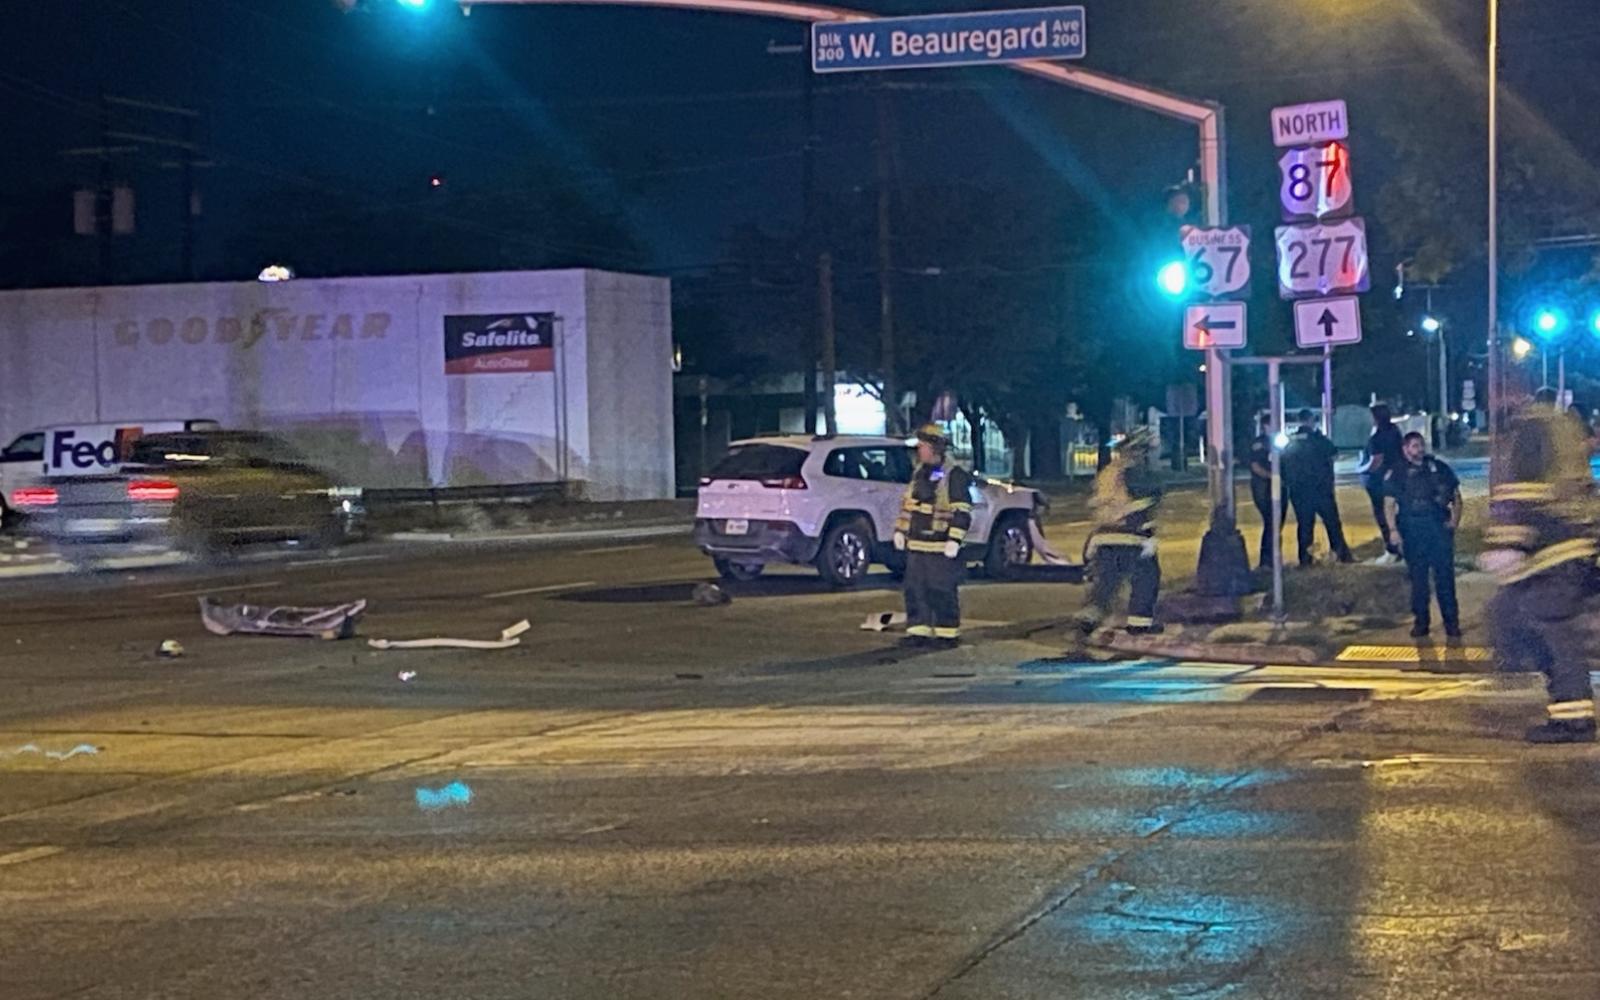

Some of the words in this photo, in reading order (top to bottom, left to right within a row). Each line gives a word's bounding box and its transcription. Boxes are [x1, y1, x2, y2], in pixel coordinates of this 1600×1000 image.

[1052, 19, 1081, 33] Ave
[818, 32, 842, 46] Blk
[850, 32, 881, 59] W.
[890, 20, 1048, 57] Beauregard
[1051, 33, 1081, 48] 200
[817, 47, 845, 61] 300
[1278, 111, 1341, 137] NORTH
[1288, 157, 1341, 202] 87
[1188, 233, 1243, 246] BUSINESS
[1190, 246, 1242, 285] 67
[1286, 235, 1356, 279] 277
[461, 329, 541, 348] Safelite
